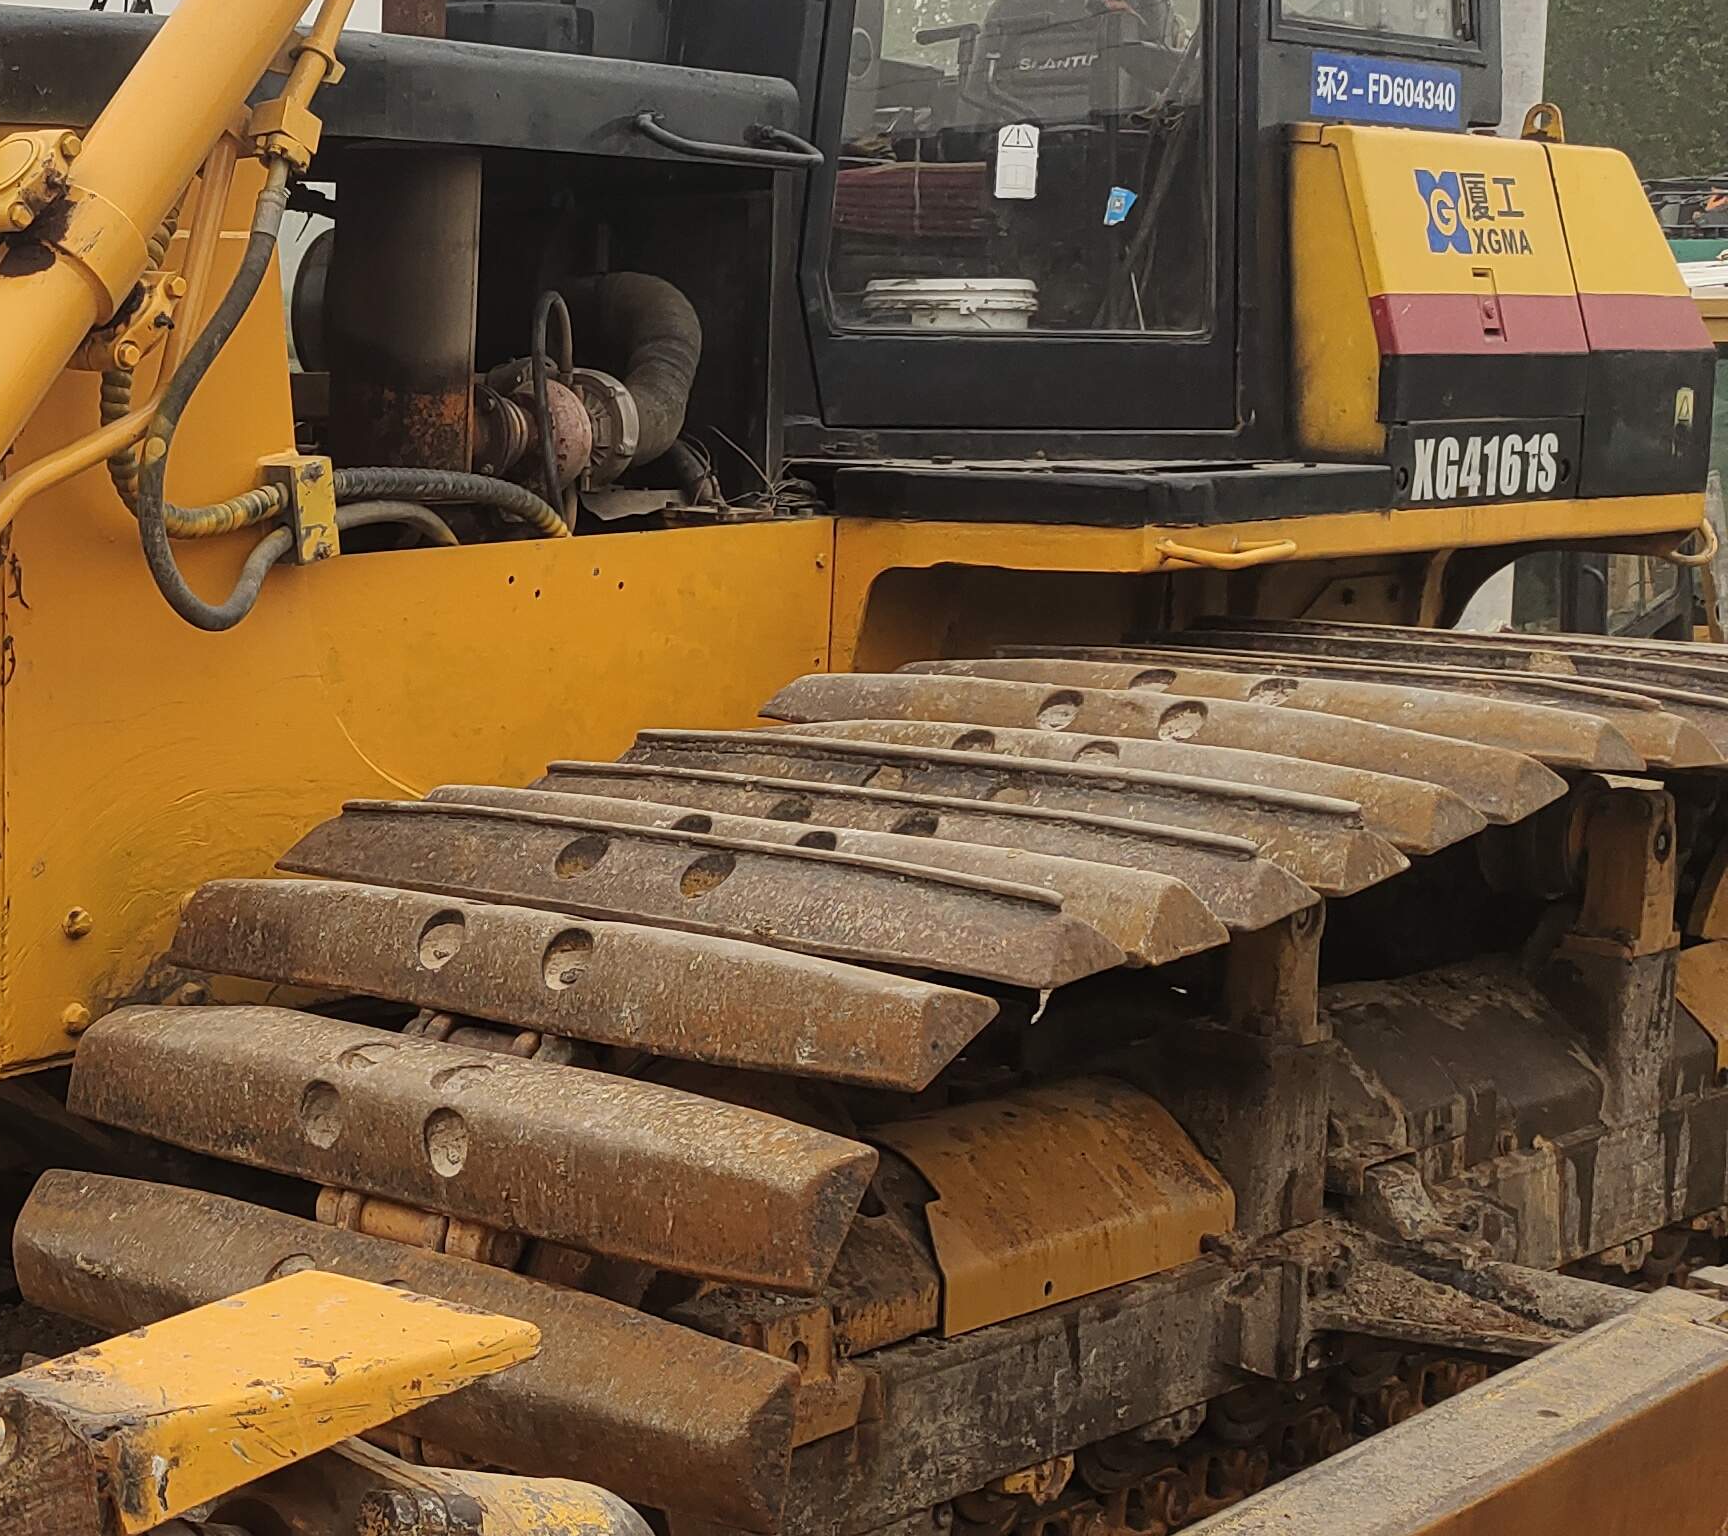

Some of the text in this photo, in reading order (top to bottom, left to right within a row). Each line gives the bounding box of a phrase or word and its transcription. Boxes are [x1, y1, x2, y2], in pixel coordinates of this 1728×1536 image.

[1459, 172, 1525, 222] 厦工
[1472, 227, 1533, 255] XGMA
[1410, 432, 1559, 501] XG4161S
